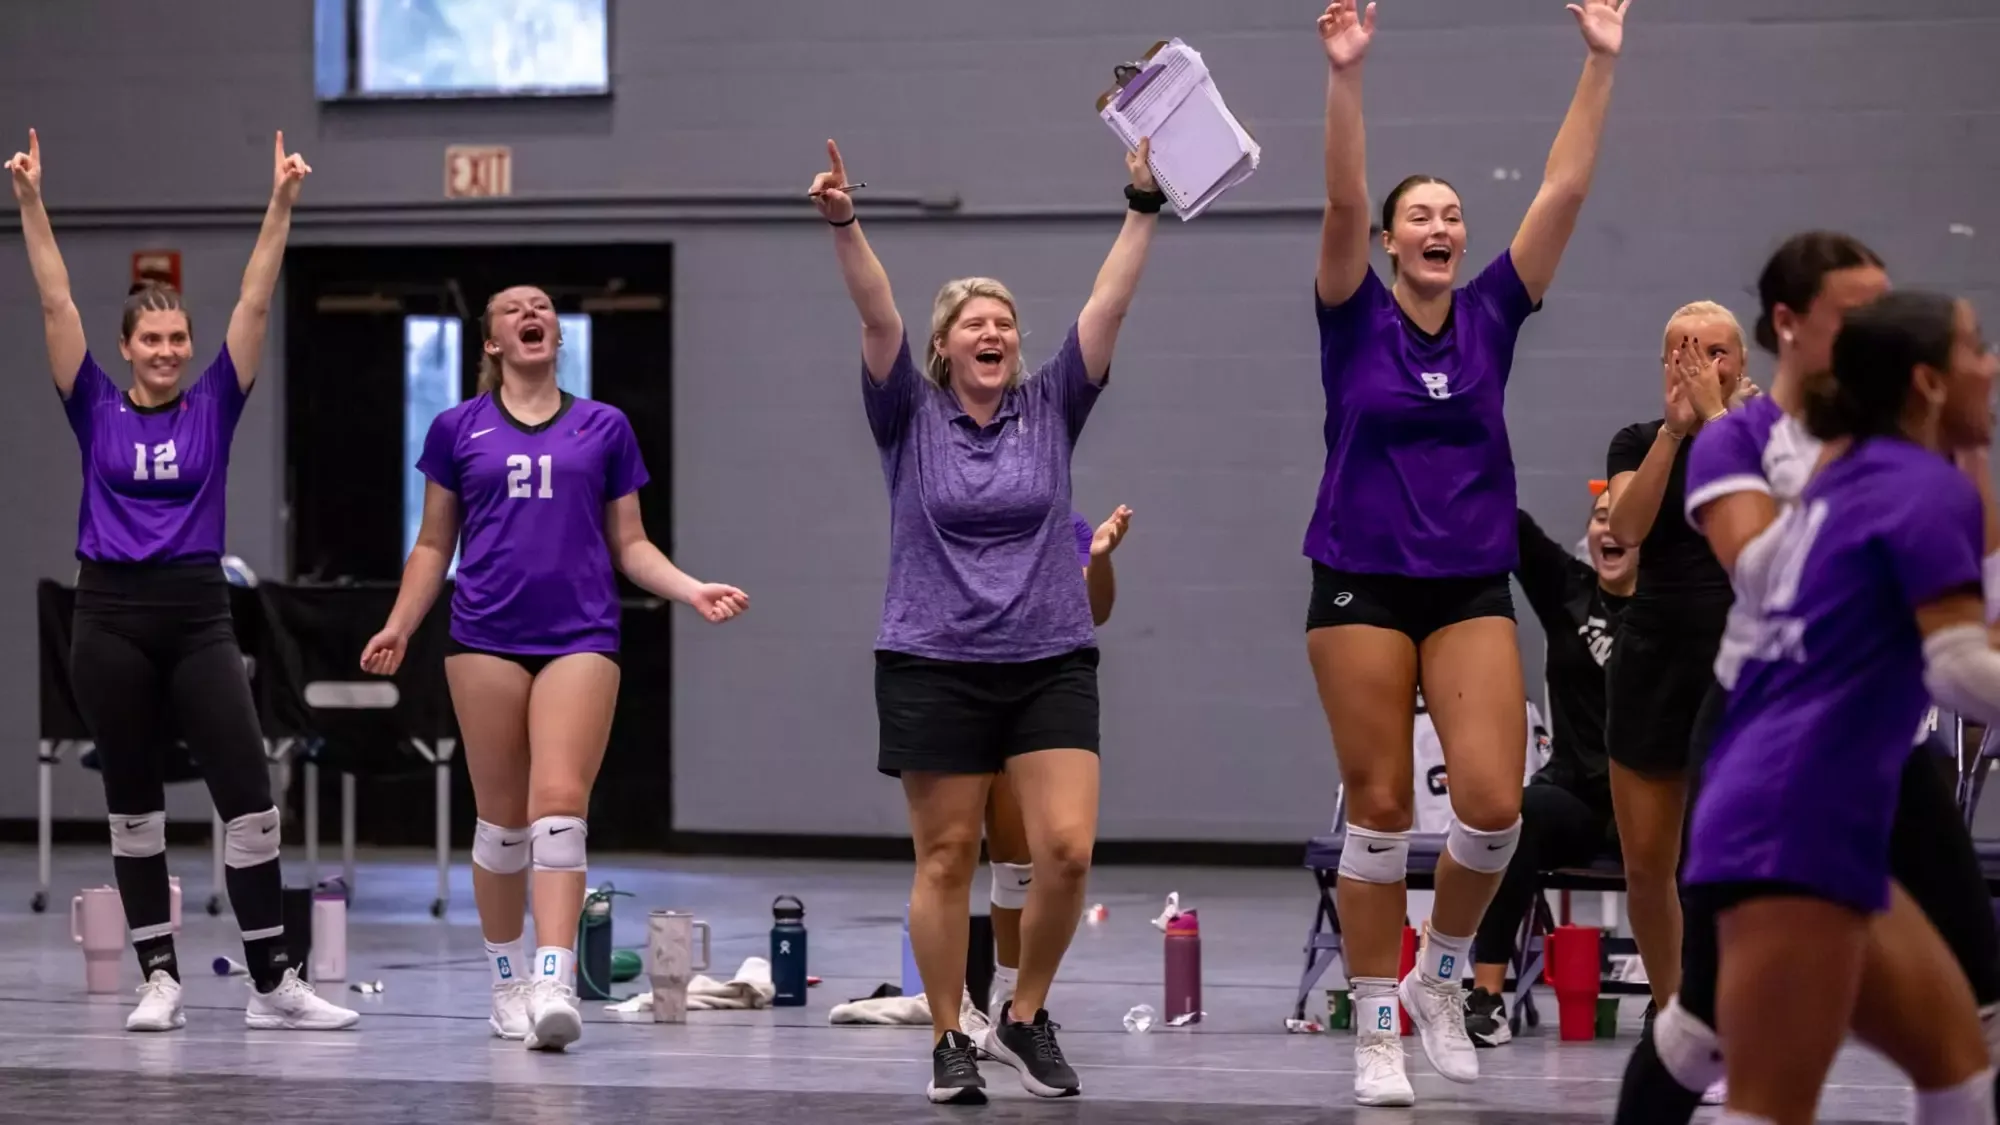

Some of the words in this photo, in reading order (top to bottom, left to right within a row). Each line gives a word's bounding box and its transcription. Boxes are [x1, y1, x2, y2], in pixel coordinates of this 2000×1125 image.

[449, 152, 507, 196] EXIT
[133, 439, 179, 480] 12
[506, 454, 553, 499] 21
